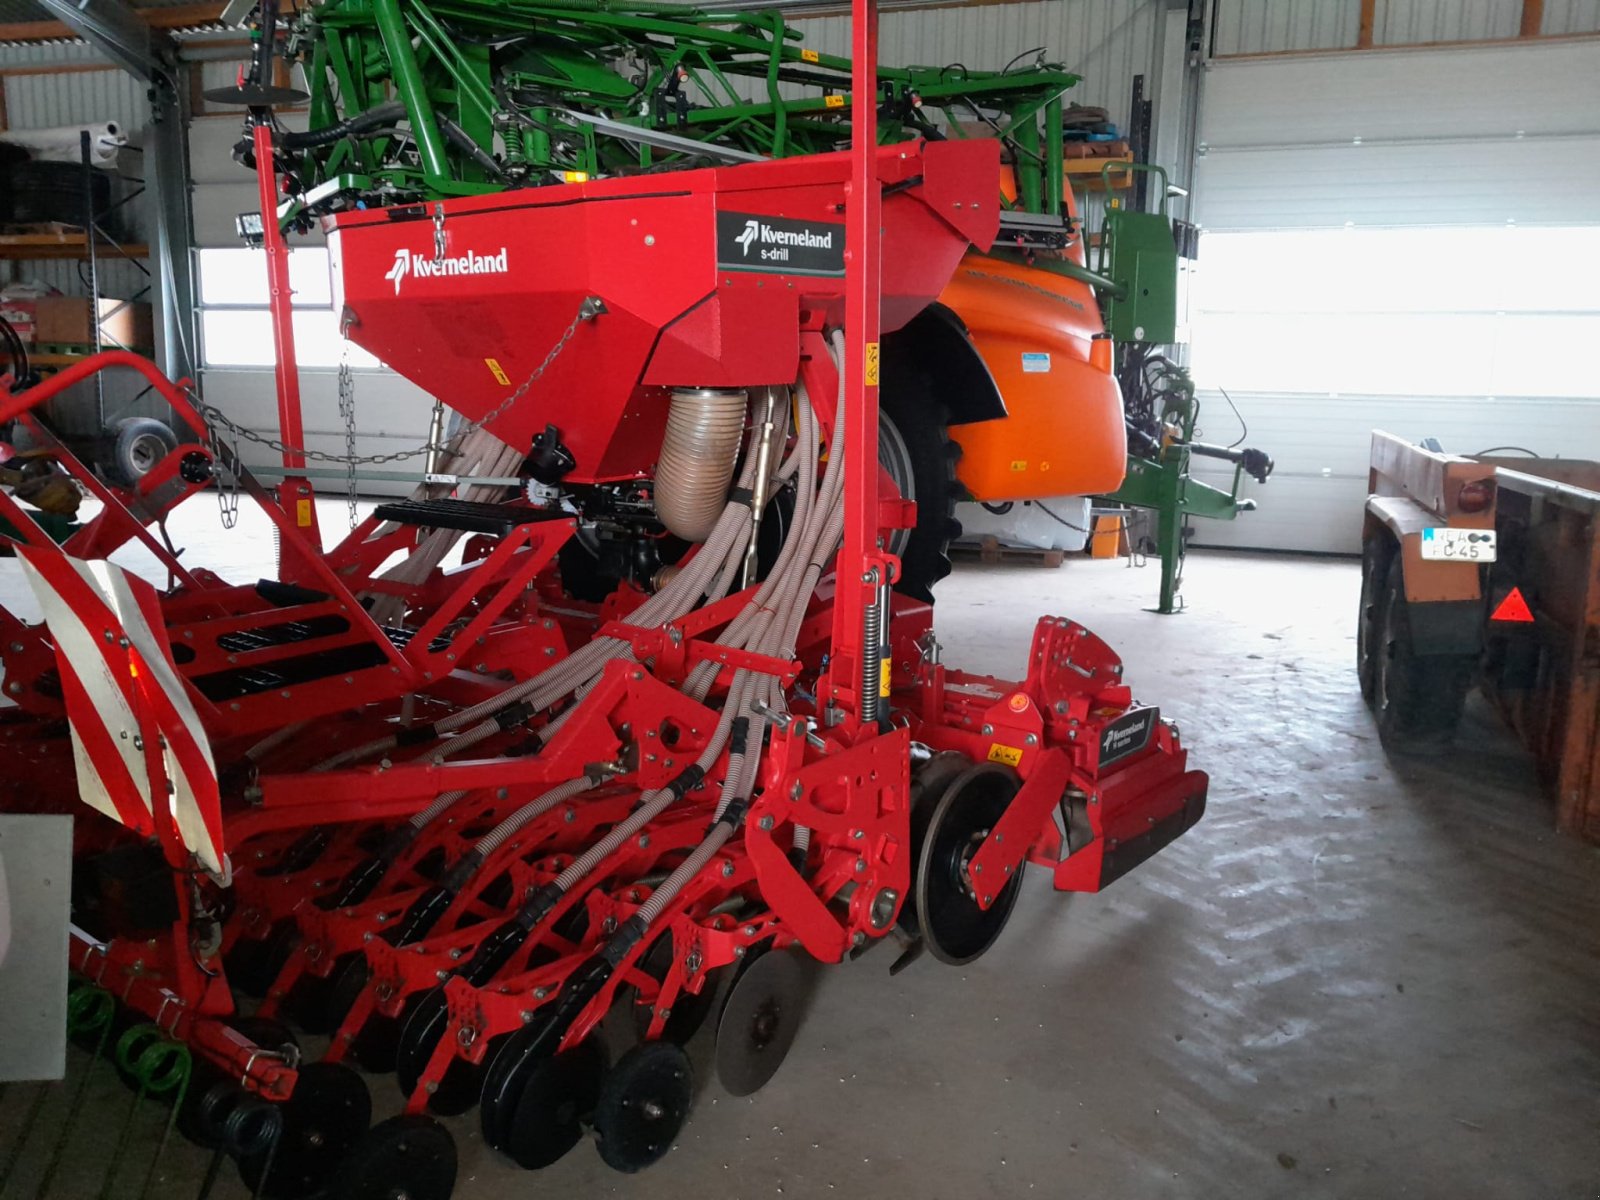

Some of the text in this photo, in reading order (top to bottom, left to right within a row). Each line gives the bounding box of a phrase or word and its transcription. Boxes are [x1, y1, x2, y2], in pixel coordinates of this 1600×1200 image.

[760, 224, 832, 249] Kverneland
[412, 247, 508, 278] Kverneland
[760, 247, 789, 261] s-drill
[1459, 545, 1479, 558] 45
